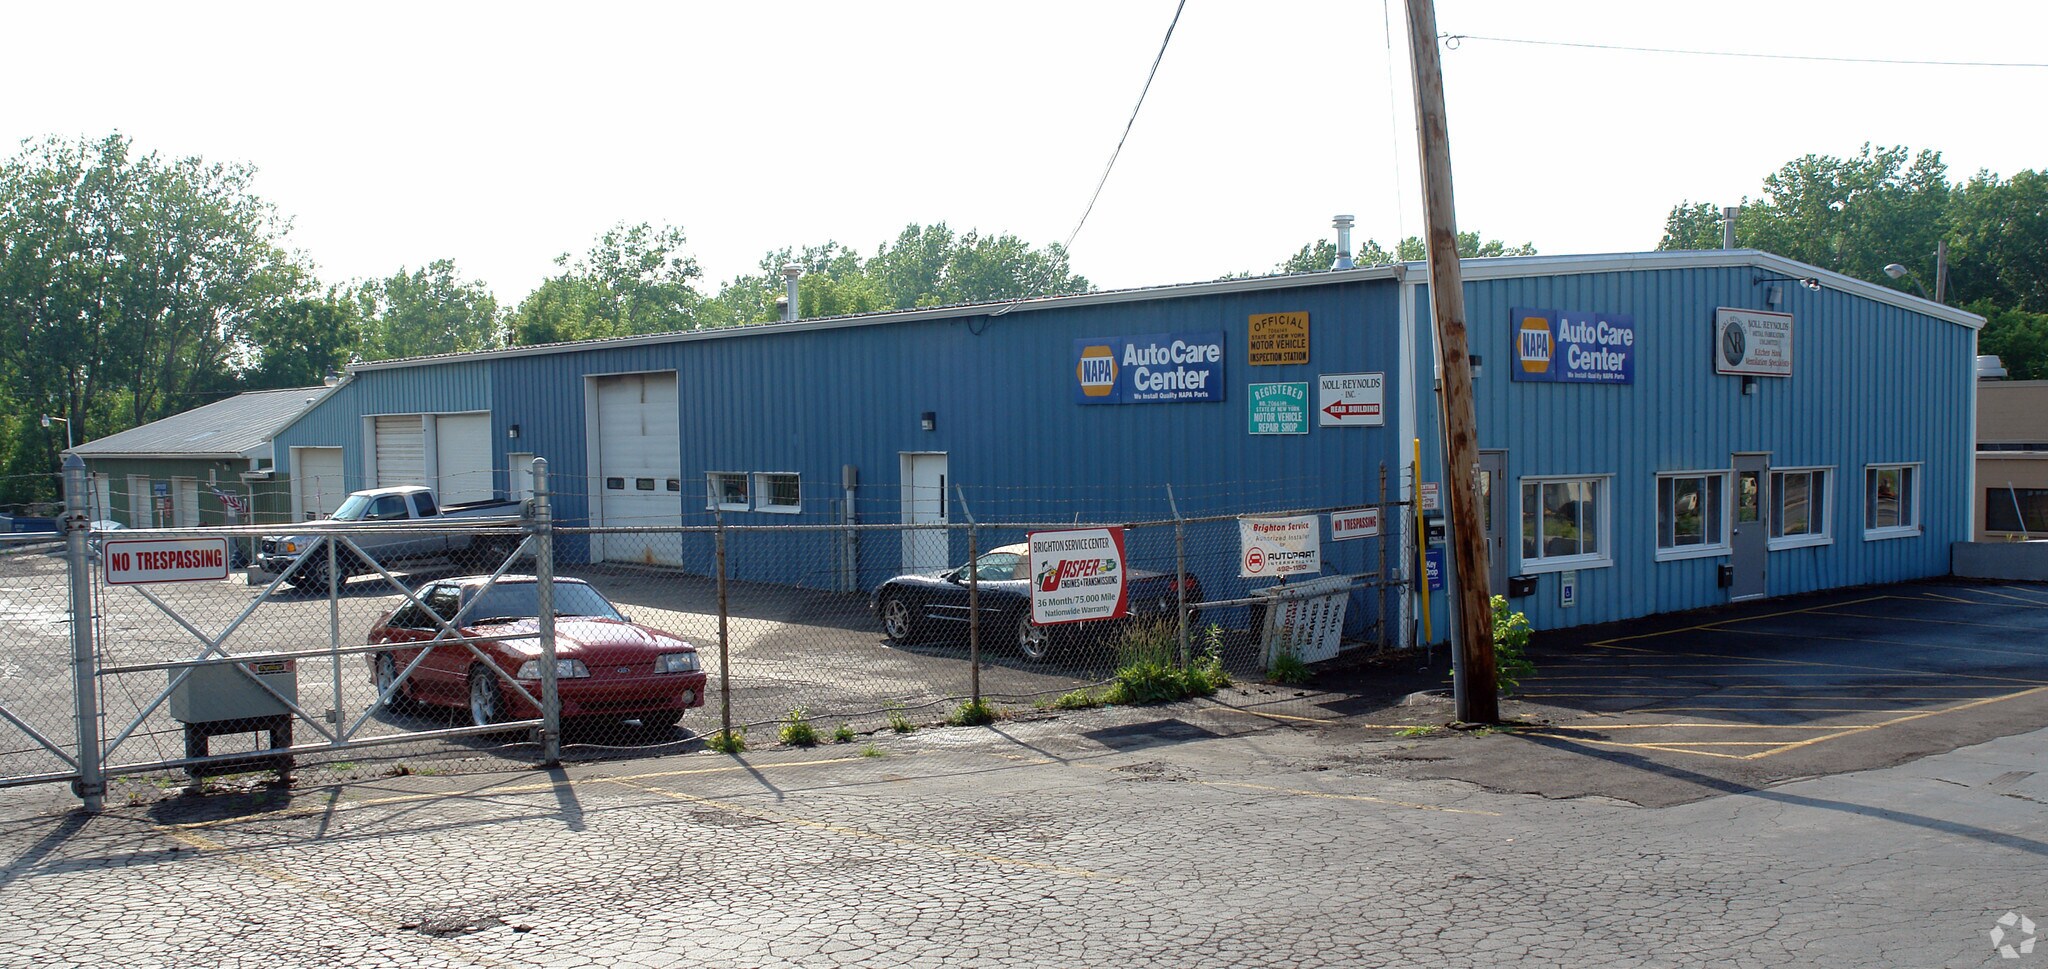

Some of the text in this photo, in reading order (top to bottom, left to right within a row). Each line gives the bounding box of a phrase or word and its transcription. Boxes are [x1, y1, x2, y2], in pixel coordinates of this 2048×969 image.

[1254, 315, 1303, 331] OFFICIAL
[1748, 319, 1789, 331] NOLL-REYNOLDS
[1250, 339, 1306, 350] MOTOR VEHICLE
[1523, 332, 1548, 358] NAPA
[1250, 351, 1306, 362] INSPECTION STATION
[1567, 343, 1625, 371] Center
[1083, 359, 1112, 383] NAPA
[1587, 372, 1602, 380] Quality
[1134, 366, 1209, 391] Center
[1322, 378, 1380, 390] NOLL-REYNOLDS
[1159, 392, 1177, 400] Quality
[1254, 384, 1303, 400] REGISTERED
[1330, 405, 1379, 413] REAR BUILDING
[1253, 411, 1303, 422] MOTOR VEHICLE
[1258, 422, 1298, 432] REPAIR SHOP
[1253, 522, 1309, 533] Brighton Service
[1334, 515, 1377, 531] NO TRESPASSING
[1034, 537, 1110, 553] BRIGHTON SERVICE CENTER
[111, 549, 223, 571] NO TRESPASSING
[1268, 550, 1316, 561] AUTOPART
[1426, 560, 1437, 569] Key
[1041, 558, 1101, 592] JASPER
[1061, 578, 1080, 589] ENGINES
[1083, 576, 1118, 587] TRANSMISSIONS
[1037, 598, 1048, 608] 36
[1101, 592, 1116, 601] Mile
[1045, 604, 1110, 617] Nationwide Warranty
[1306, 603, 1319, 645] BRAKES
[1329, 604, 1341, 633] TIRES
